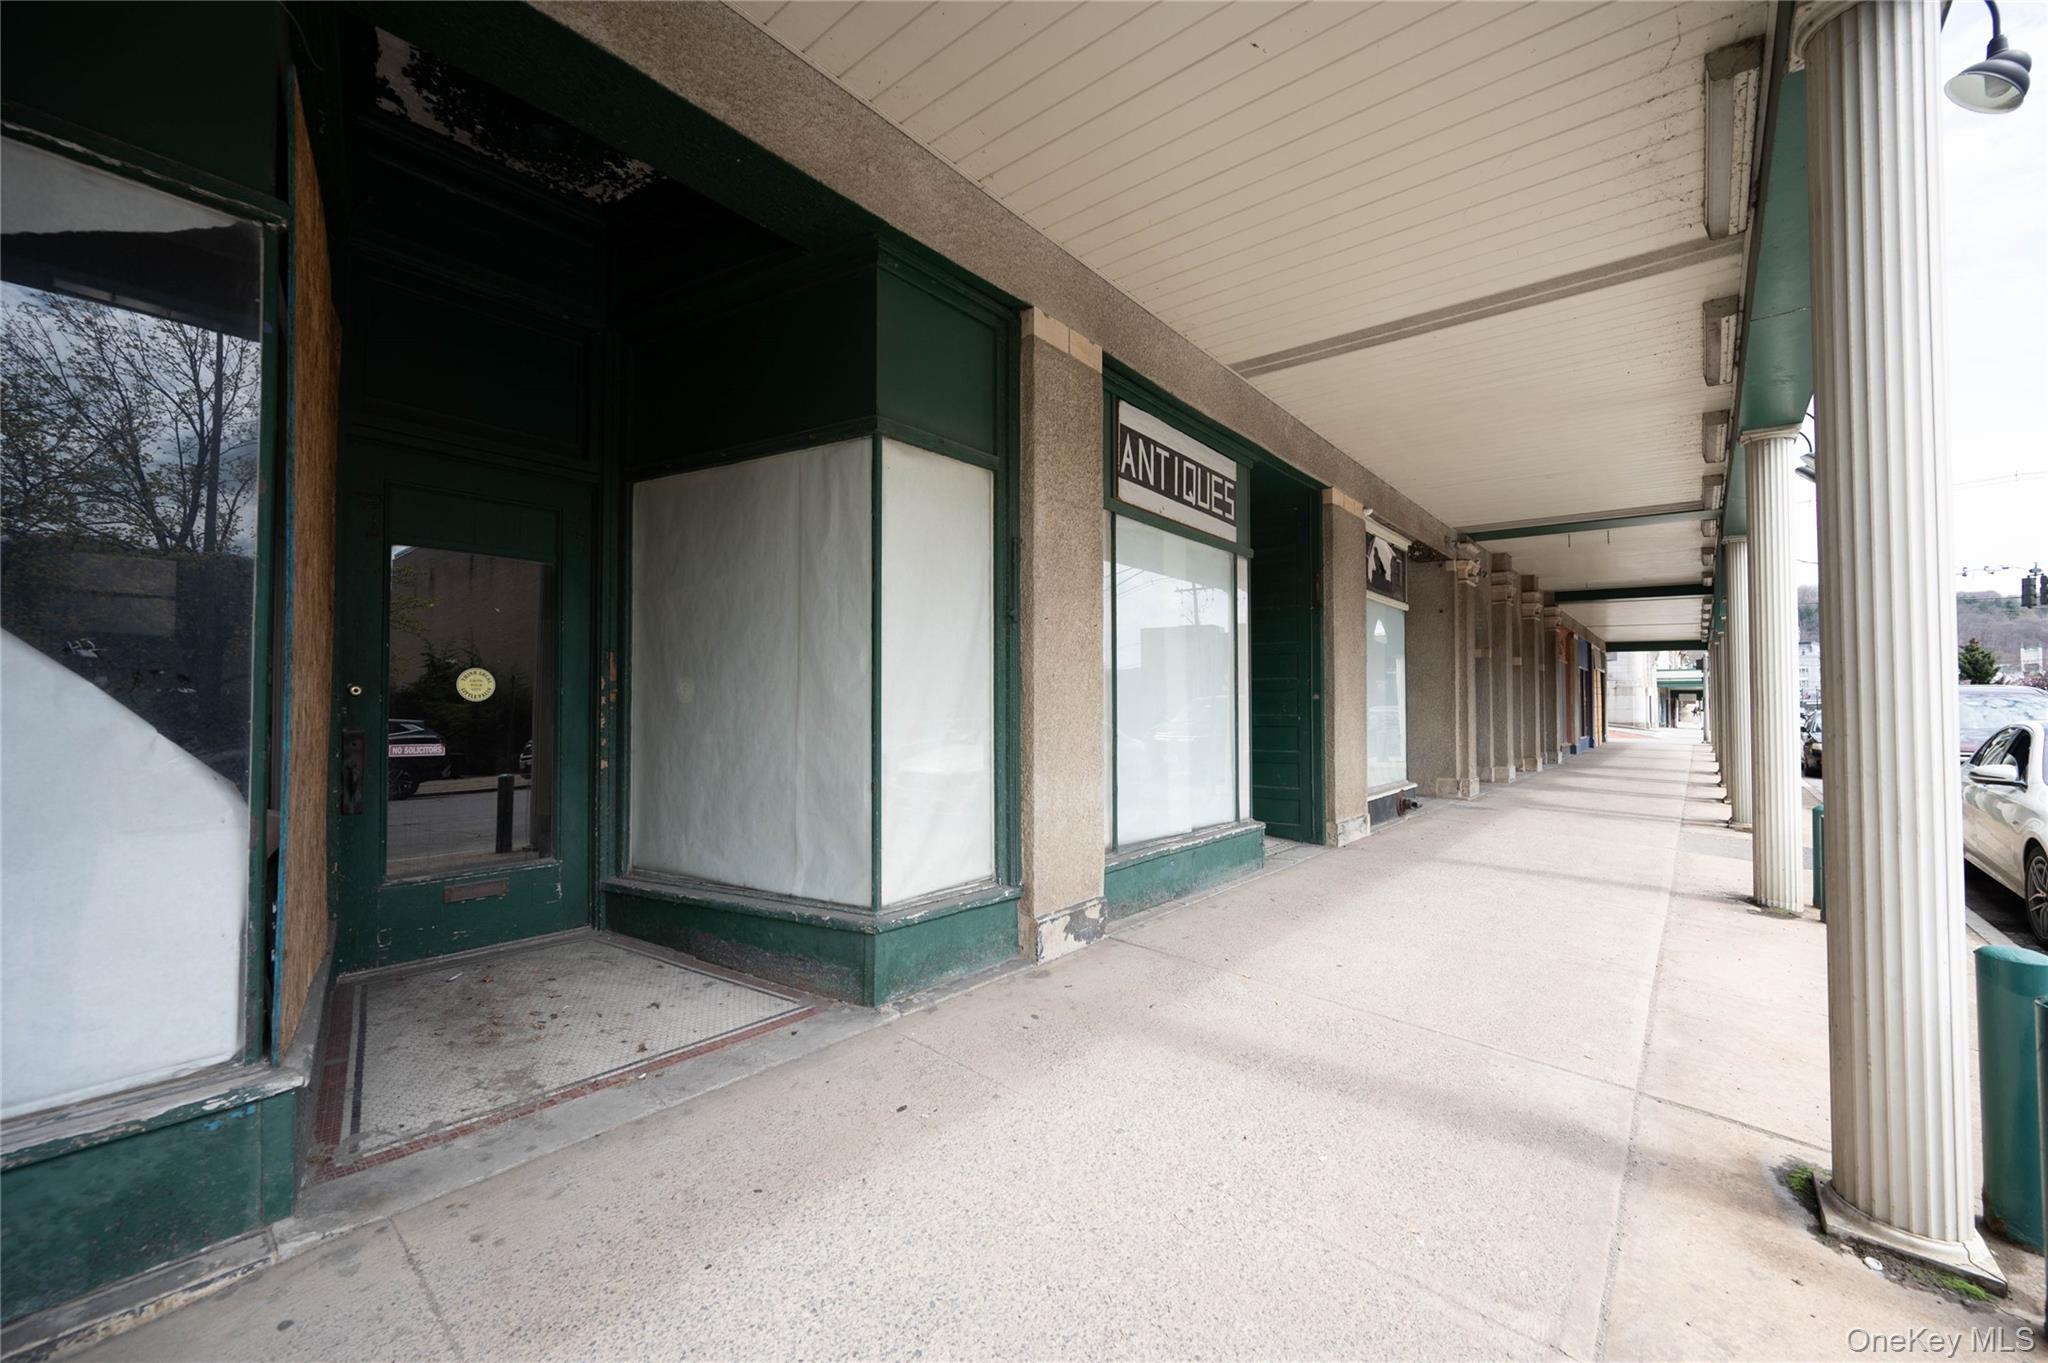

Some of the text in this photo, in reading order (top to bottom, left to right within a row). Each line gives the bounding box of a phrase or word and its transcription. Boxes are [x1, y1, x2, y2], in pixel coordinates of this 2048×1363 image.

[1120, 432, 1235, 521] ANTIQUES
[392, 746, 442, 755] NO SOLICITORS
